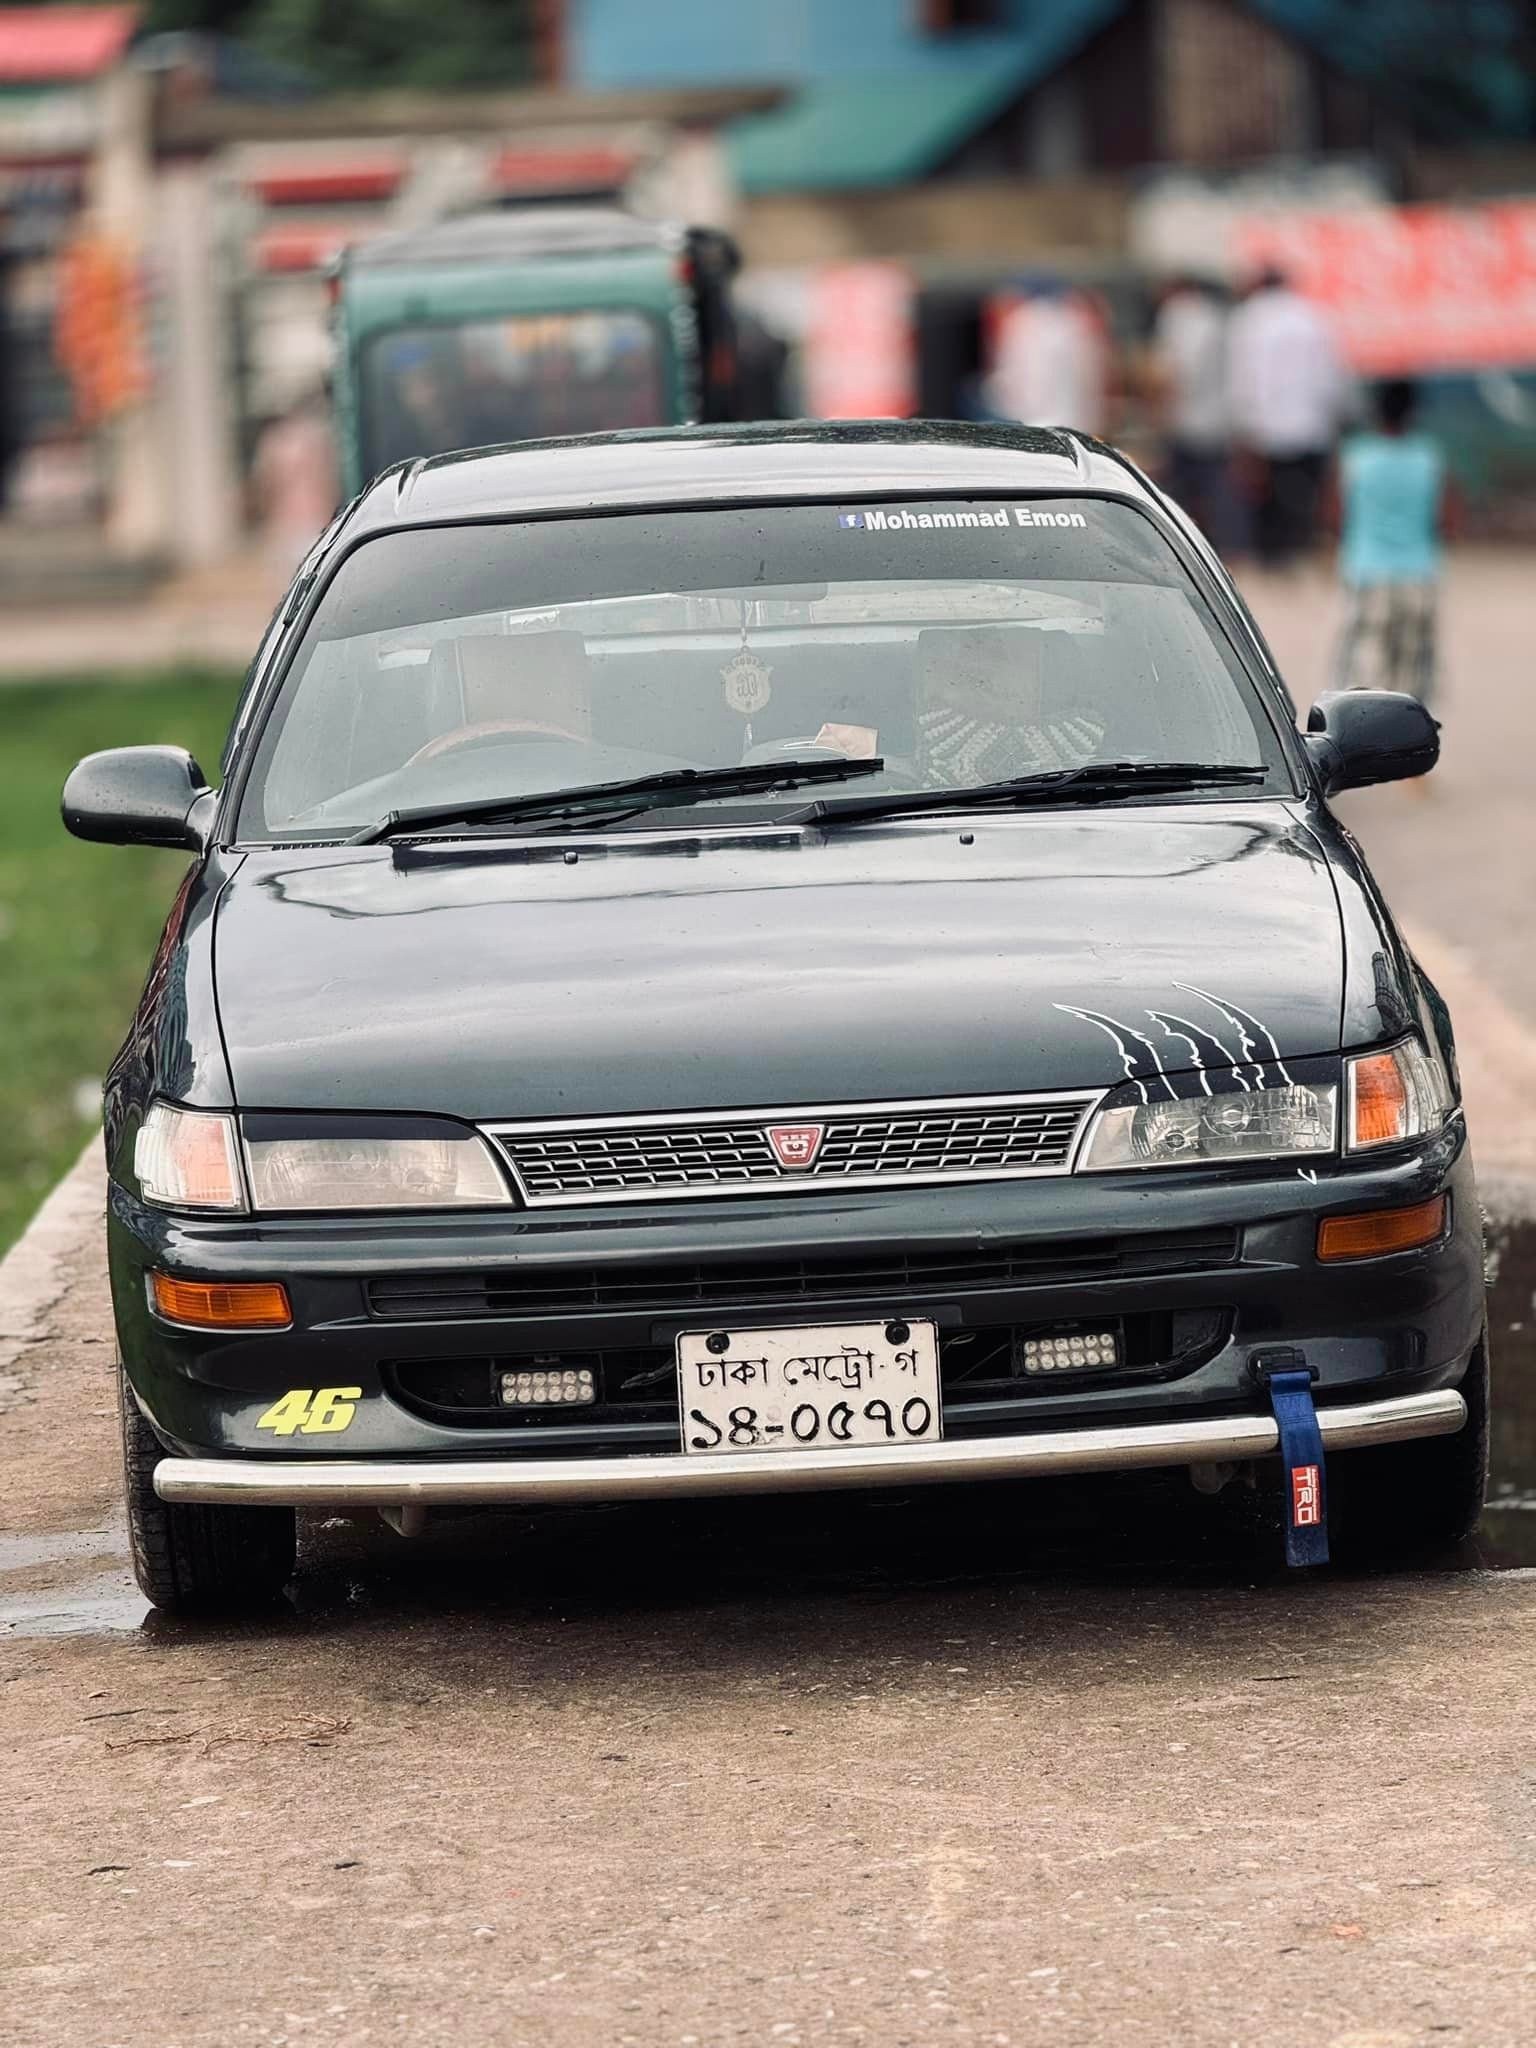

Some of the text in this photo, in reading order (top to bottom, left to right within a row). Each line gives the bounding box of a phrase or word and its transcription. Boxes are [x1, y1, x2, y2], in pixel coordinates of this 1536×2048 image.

[863, 508, 1010, 531] Mohammad
[1014, 508, 1087, 528] Emon
[695, 1355, 768, 1388] ঢাকা
[255, 1386, 362, 1435] 46
[690, 1396, 931, 1449] ১৪-০৫৭০
[1296, 1467, 1313, 1524] TRD
